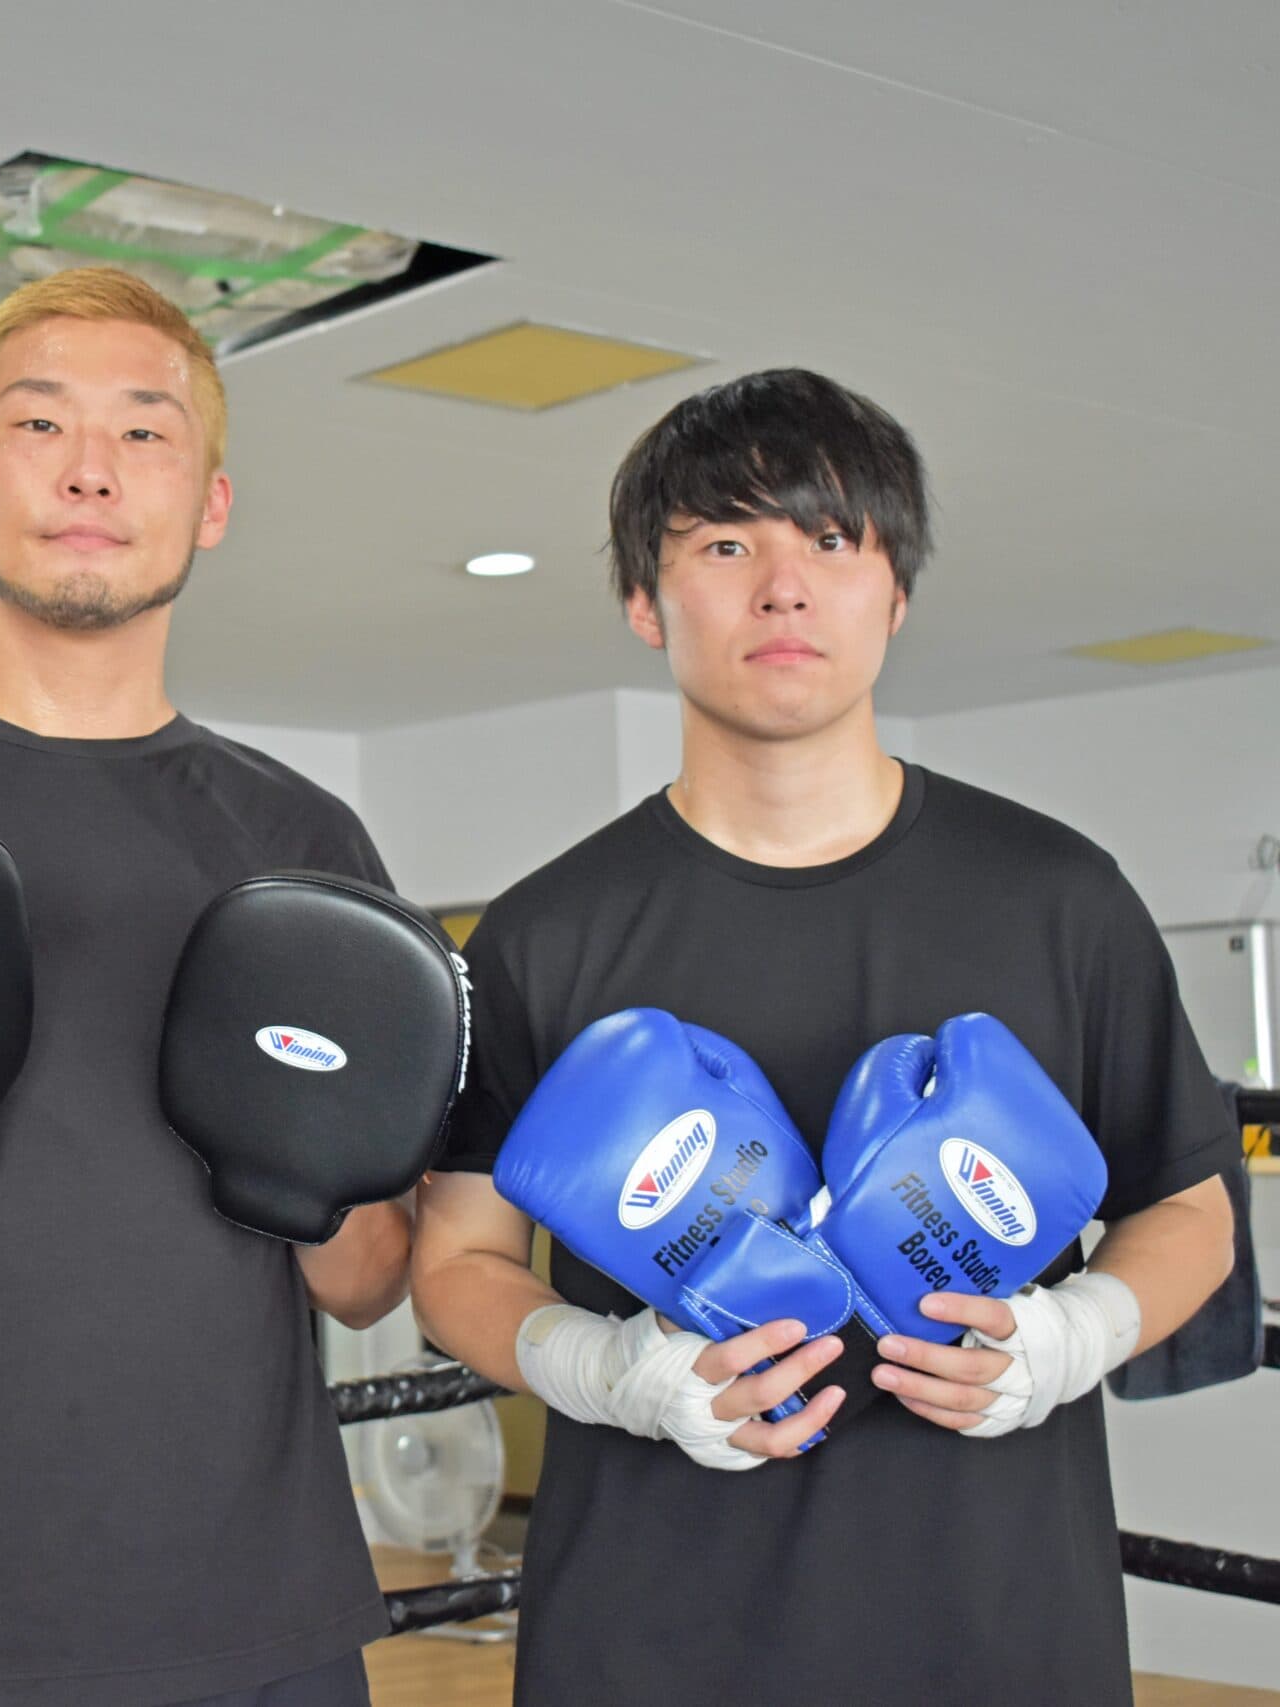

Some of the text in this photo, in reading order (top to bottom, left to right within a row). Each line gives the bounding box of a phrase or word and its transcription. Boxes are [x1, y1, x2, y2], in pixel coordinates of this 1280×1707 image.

[269, 1031, 336, 1067] Winning
[625, 1121, 708, 1209] Winning
[651, 1203, 723, 1278] Fitness
[710, 1140, 768, 1205] Studio
[958, 1147, 1026, 1238] Winning
[890, 1171, 960, 1248] Fitness
[952, 1239, 1002, 1294] Studio
[897, 1229, 952, 1292] Boxeo
